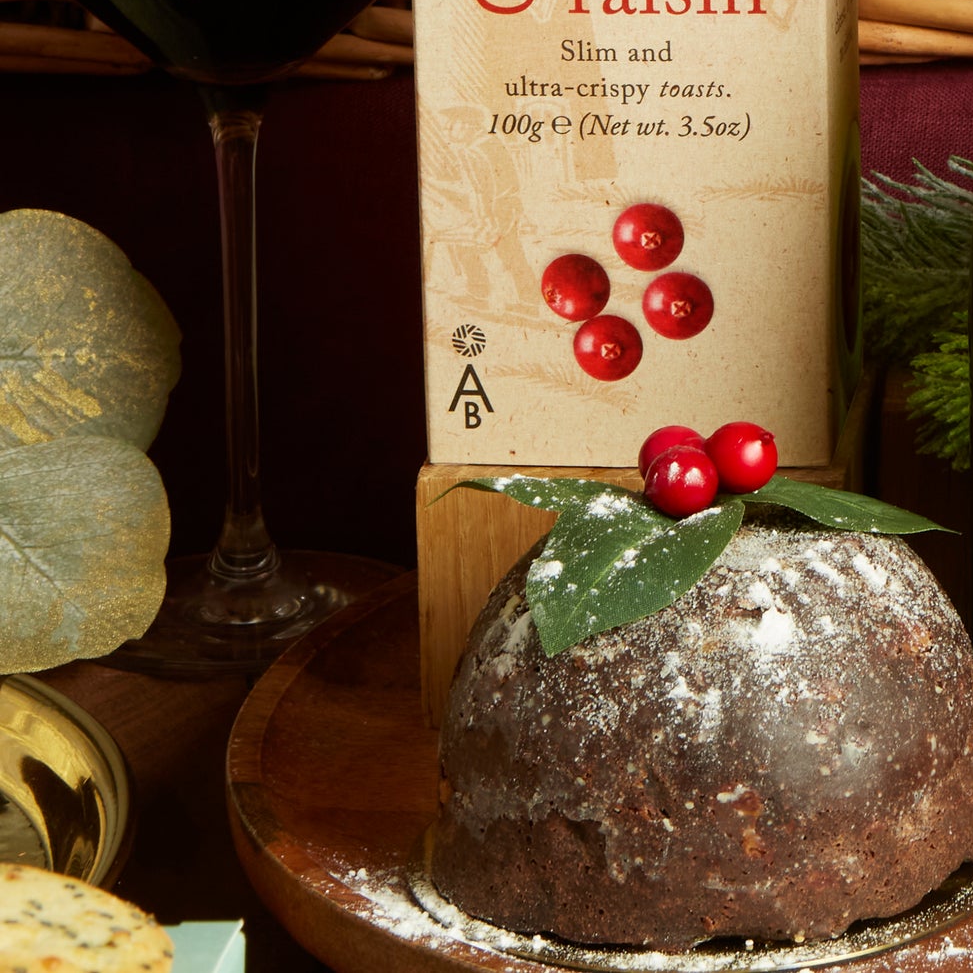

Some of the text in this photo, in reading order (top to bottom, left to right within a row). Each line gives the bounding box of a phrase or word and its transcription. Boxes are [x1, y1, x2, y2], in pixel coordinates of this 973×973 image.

[561, 39, 673, 63] Slim and
[504, 75, 733, 105] ultra-crispy toasts.
[488, 113, 545, 143] 100g
[579, 112, 631, 140] (Net
[637, 116, 670, 137] wt.
[678, 113, 751, 141] 3.5oz)
